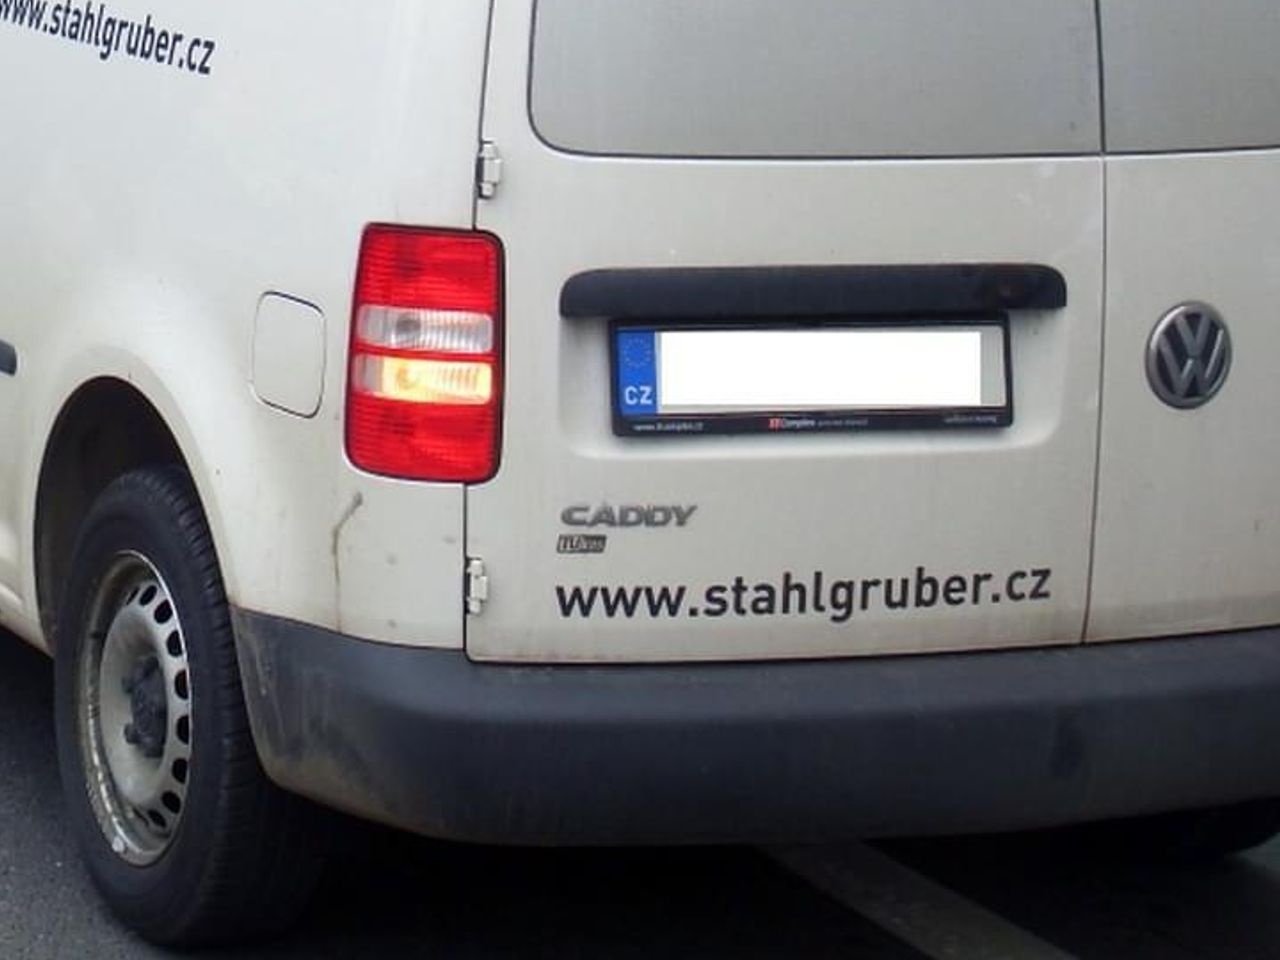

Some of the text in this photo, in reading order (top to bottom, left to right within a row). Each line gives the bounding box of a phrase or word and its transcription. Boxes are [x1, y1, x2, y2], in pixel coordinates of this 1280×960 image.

[624, 385, 653, 406] CZ
[560, 504, 697, 528] CADDY
[556, 566, 1052, 623] www.stahlgruber.cz
